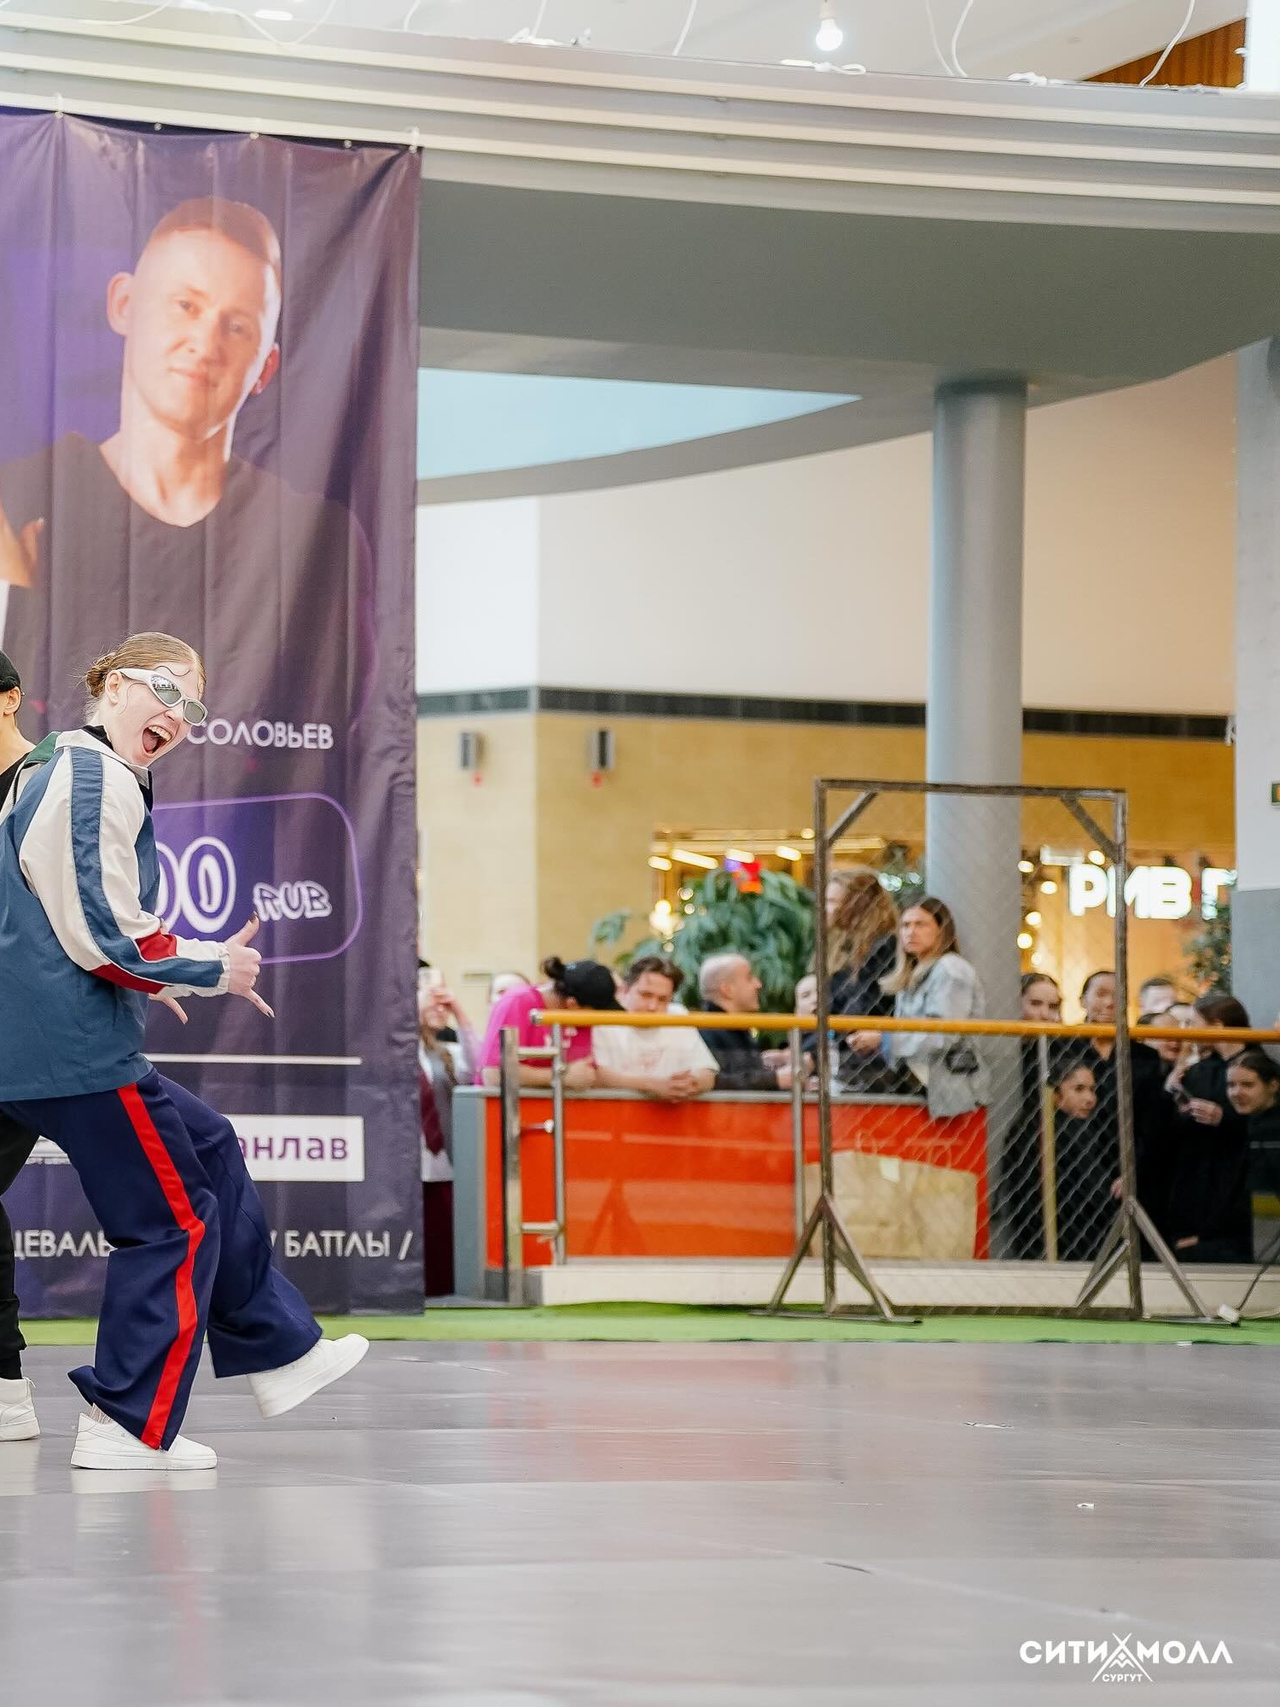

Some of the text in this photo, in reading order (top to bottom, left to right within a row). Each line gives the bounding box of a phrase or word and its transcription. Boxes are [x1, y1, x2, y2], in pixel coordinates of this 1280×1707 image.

[187, 718, 334, 749] СОЛОВЬЕВ
[253, 881, 332, 922] RUB
[284, 1229, 391, 1258] БАТТЛЫ
